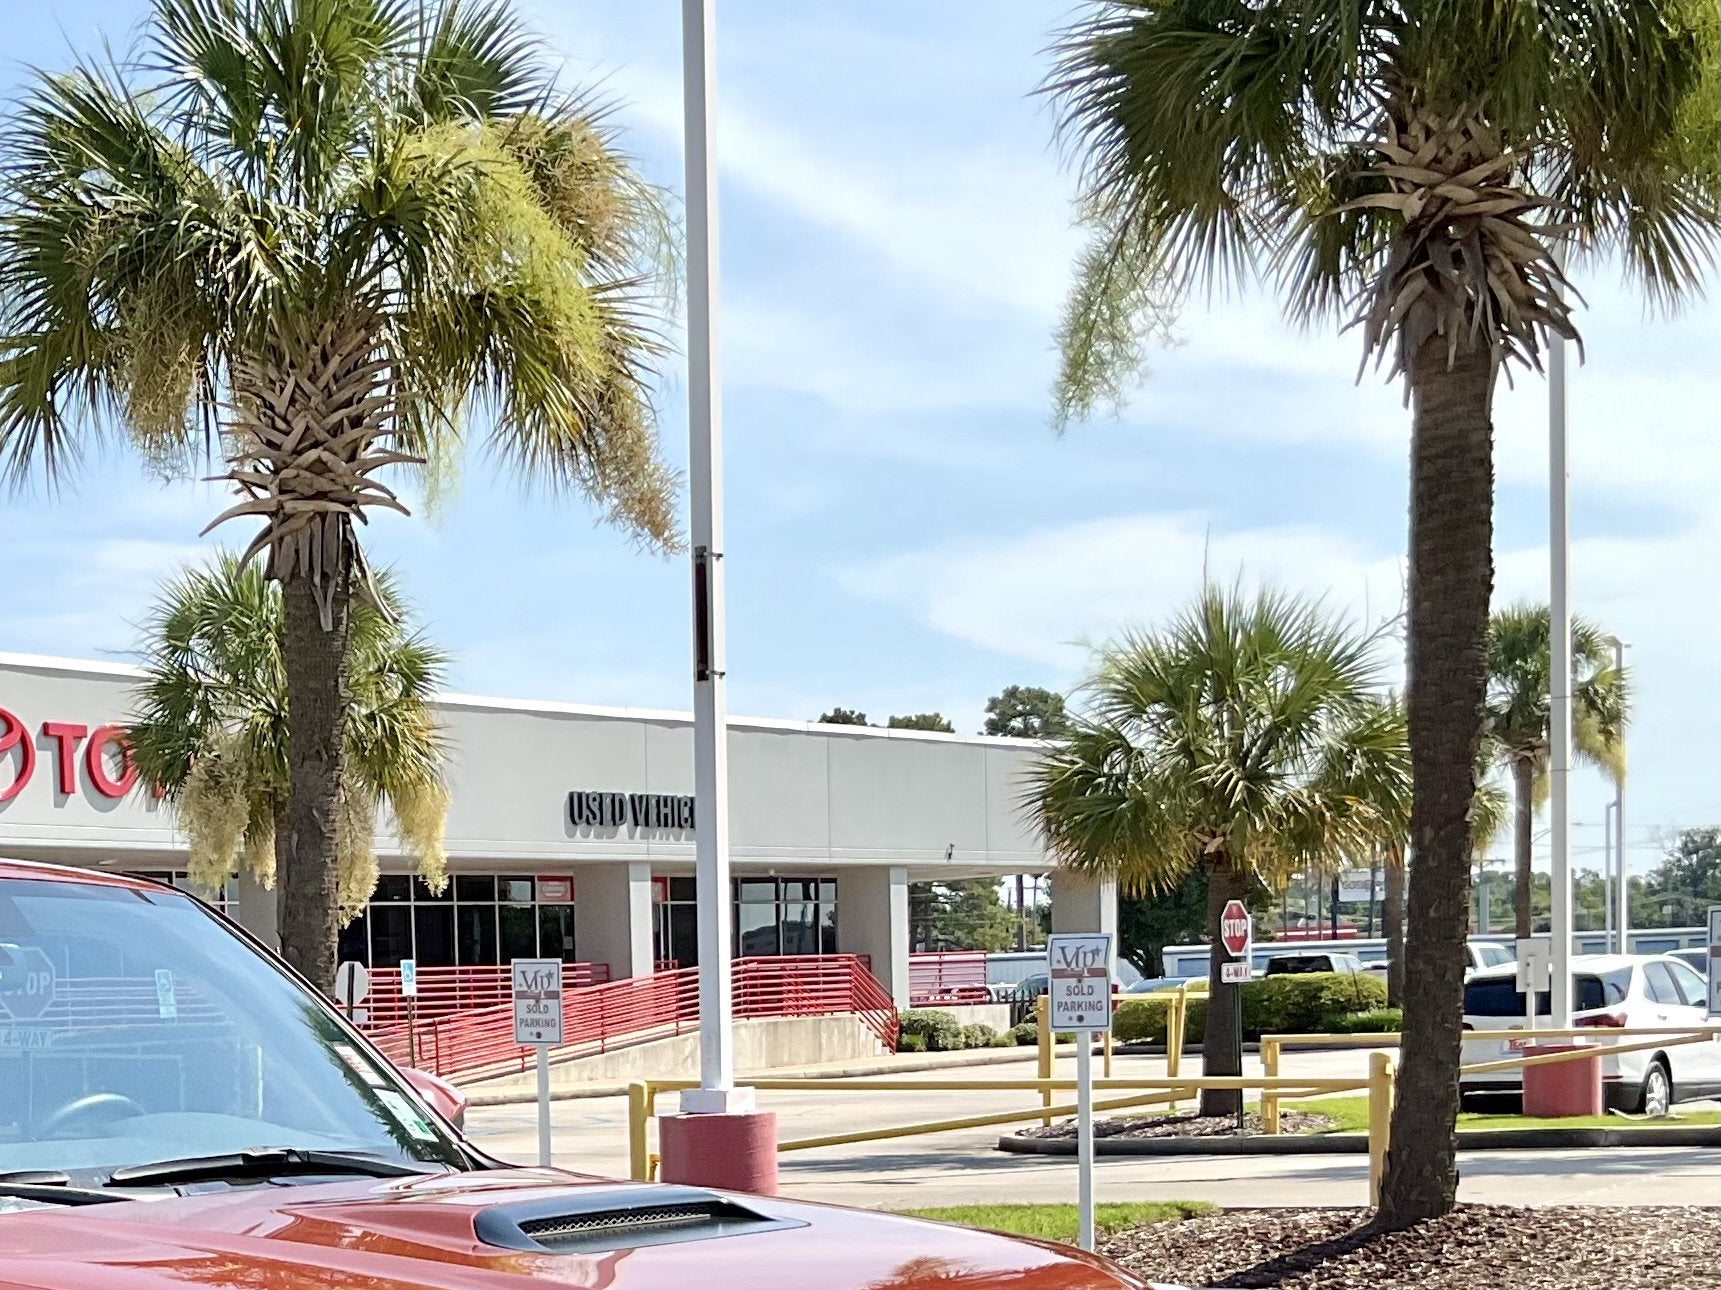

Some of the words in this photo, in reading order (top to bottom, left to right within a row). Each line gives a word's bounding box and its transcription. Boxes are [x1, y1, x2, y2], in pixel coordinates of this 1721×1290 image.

[567, 791, 627, 826] USED
[1224, 918, 1247, 938] STOP
[1225, 966, 1249, 978] 4-WAY
[1065, 984, 1095, 996] SOLD
[526, 1003, 549, 1014] SOLD
[1057, 1000, 1104, 1013] PARKING
[519, 1017, 557, 1028] PARKING
[3, 1031, 49, 1048] 4-WAY
